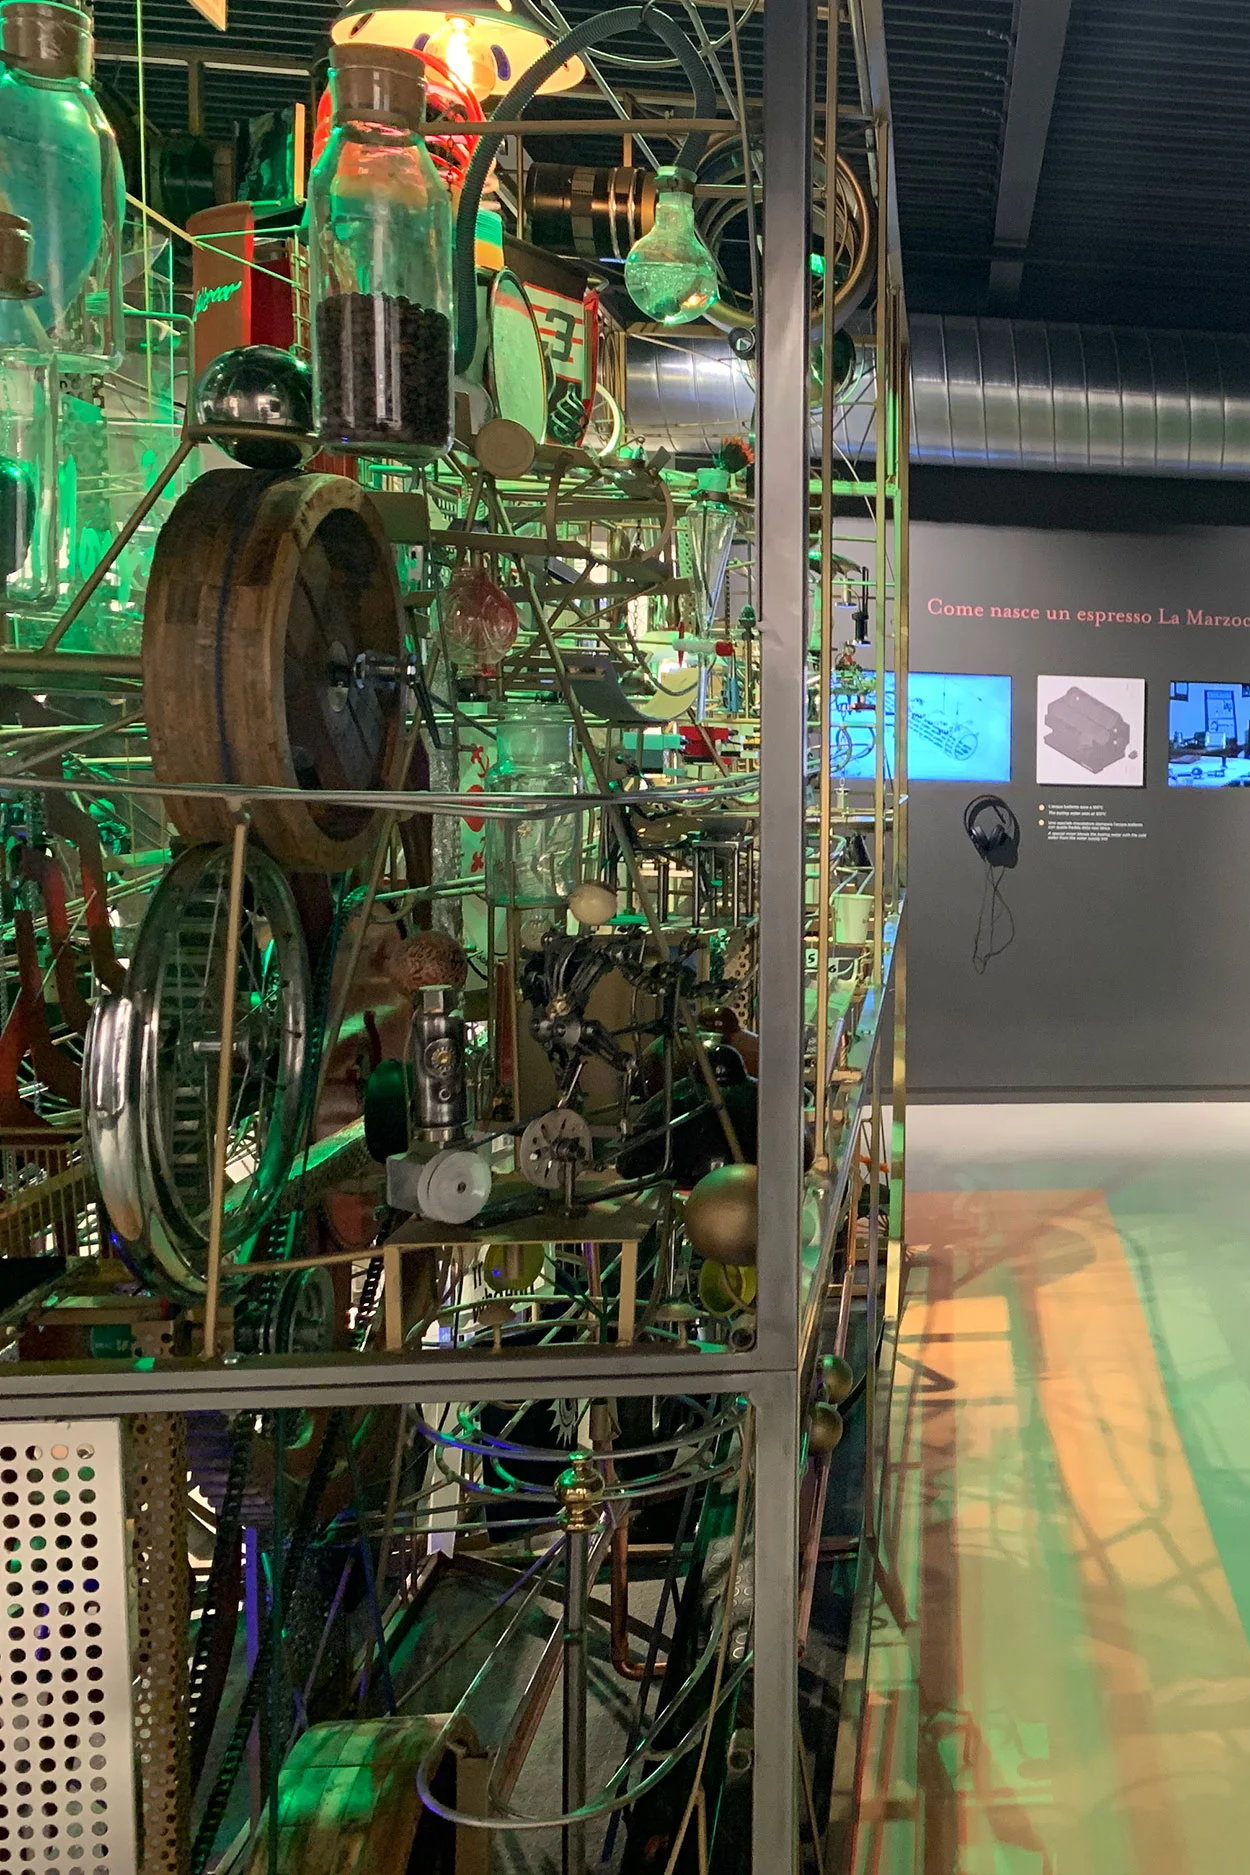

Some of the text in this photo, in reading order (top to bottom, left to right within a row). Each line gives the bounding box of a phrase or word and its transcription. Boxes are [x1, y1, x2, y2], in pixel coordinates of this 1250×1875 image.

[541, 308, 575, 362] 3
[927, 598, 984, 617] Come
[990, 606, 1040, 620] nasce
[1046, 608, 1070, 621] un
[1076, 609, 1152, 627] espresso
[1158, 608, 1180, 625] La
[808, 953, 815, 963] 5
